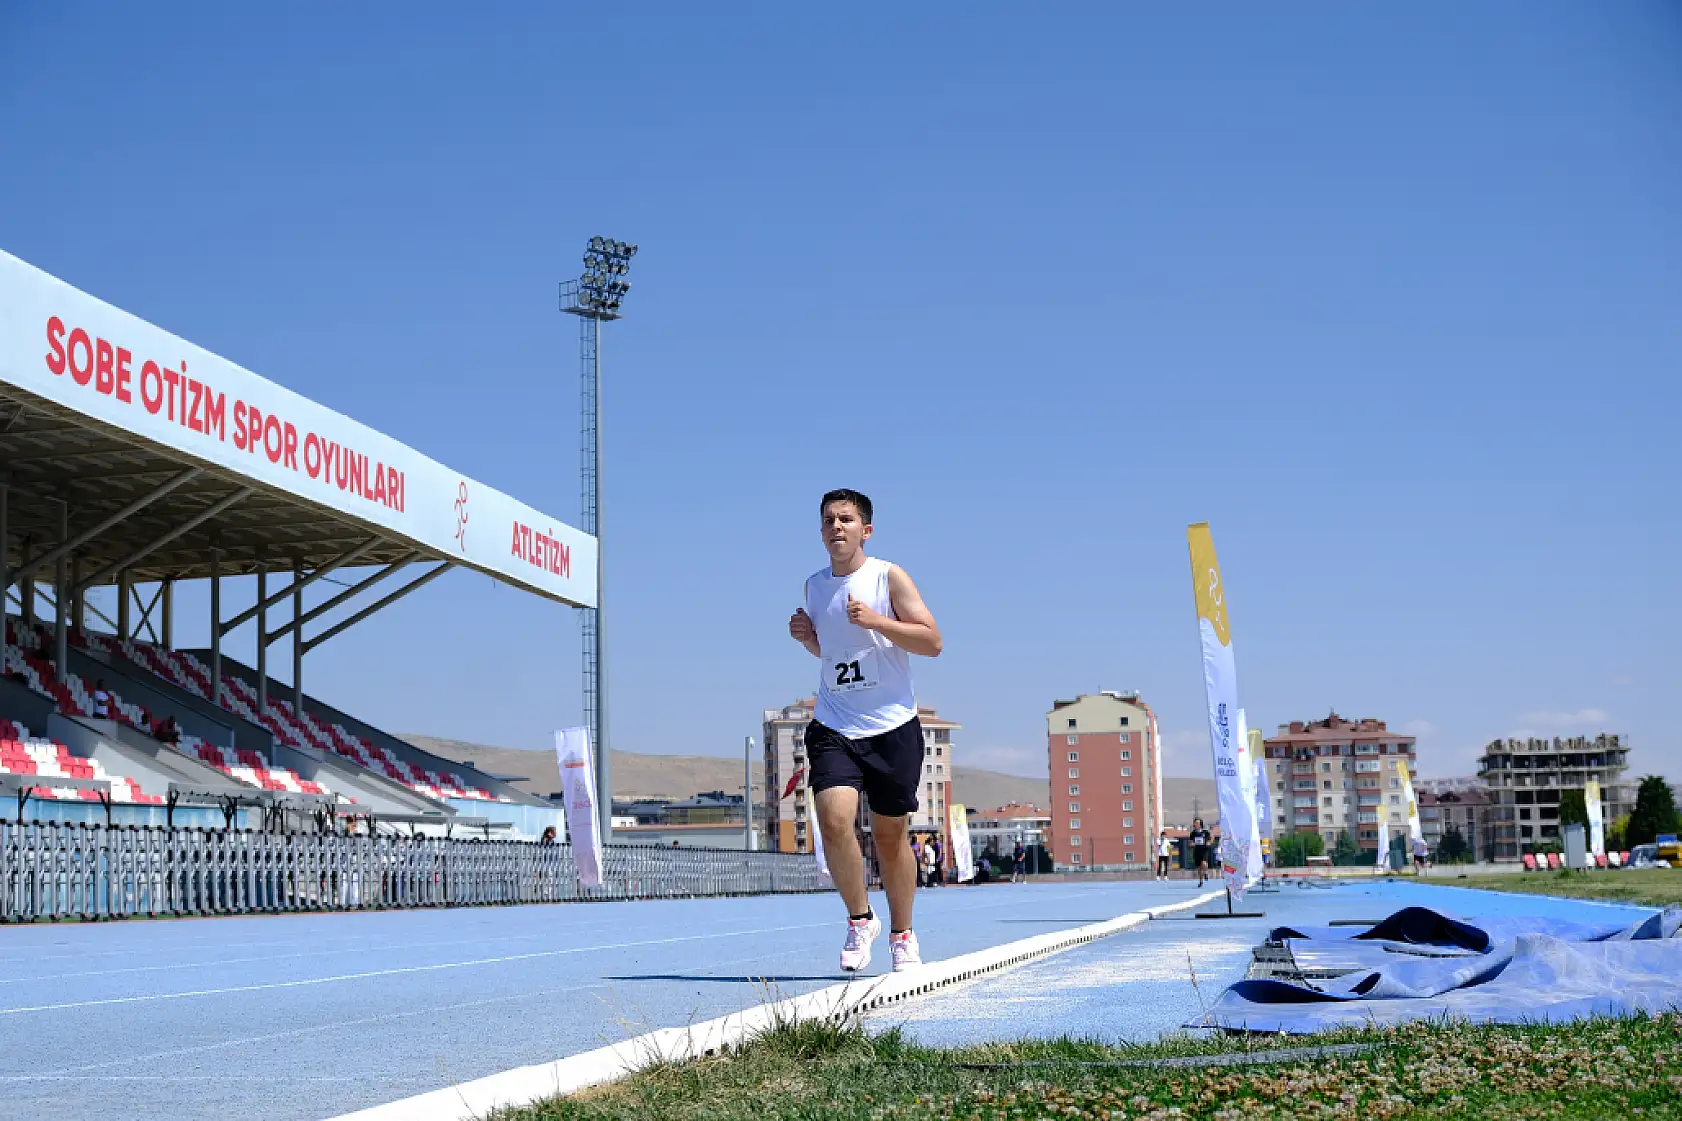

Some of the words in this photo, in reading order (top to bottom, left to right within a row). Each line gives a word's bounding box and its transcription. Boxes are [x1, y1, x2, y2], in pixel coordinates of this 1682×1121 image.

[46, 315, 132, 404] SOBE
[140, 359, 226, 442] OTİZM
[233, 399, 298, 471] SPOR
[303, 432, 405, 513] OYUNLARI
[511, 520, 570, 579] ATLETİZM
[834, 660, 865, 685] 21
